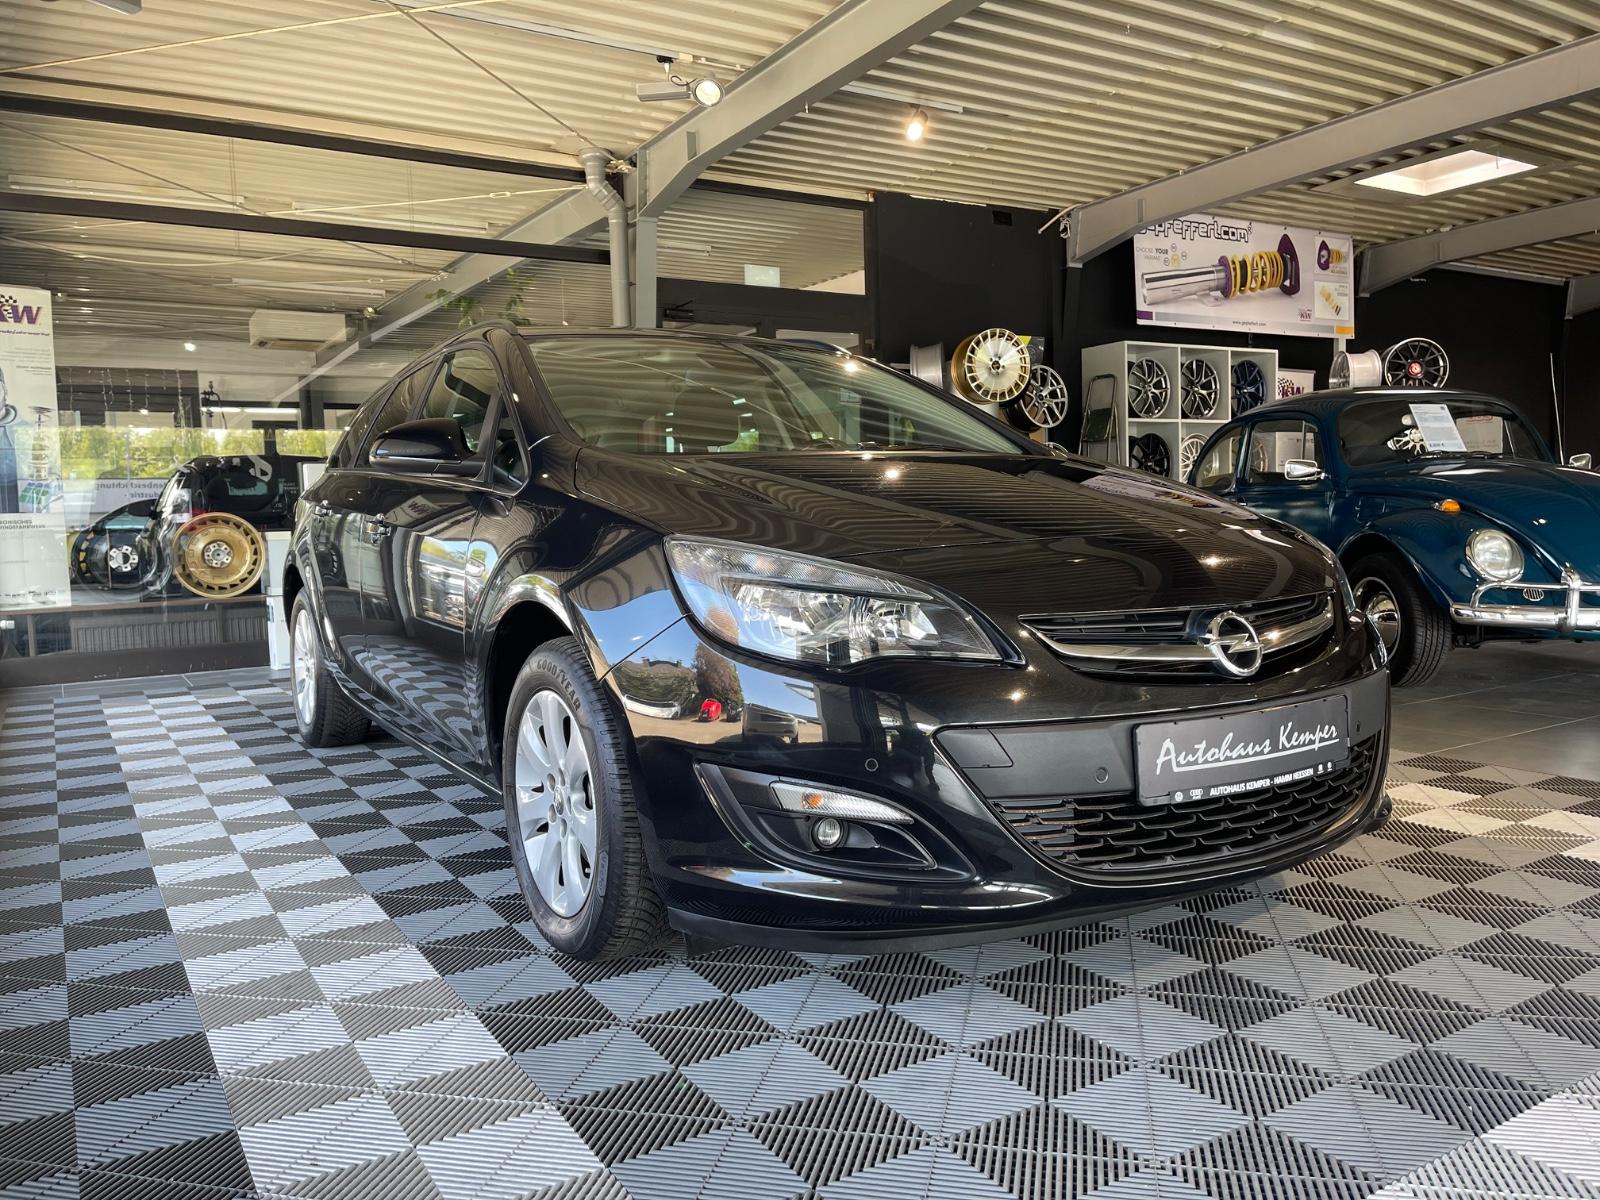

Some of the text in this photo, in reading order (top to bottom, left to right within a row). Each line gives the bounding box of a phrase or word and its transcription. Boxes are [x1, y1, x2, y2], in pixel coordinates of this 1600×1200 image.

[536, 659, 582, 712] GOODYEAR
[1156, 721, 1338, 775] Autohaus Kemper
[1210, 782, 1246, 797] AUTOHAUS
[1246, 779, 1271, 791] KEMPER
[1274, 774, 1293, 785] HAMM
